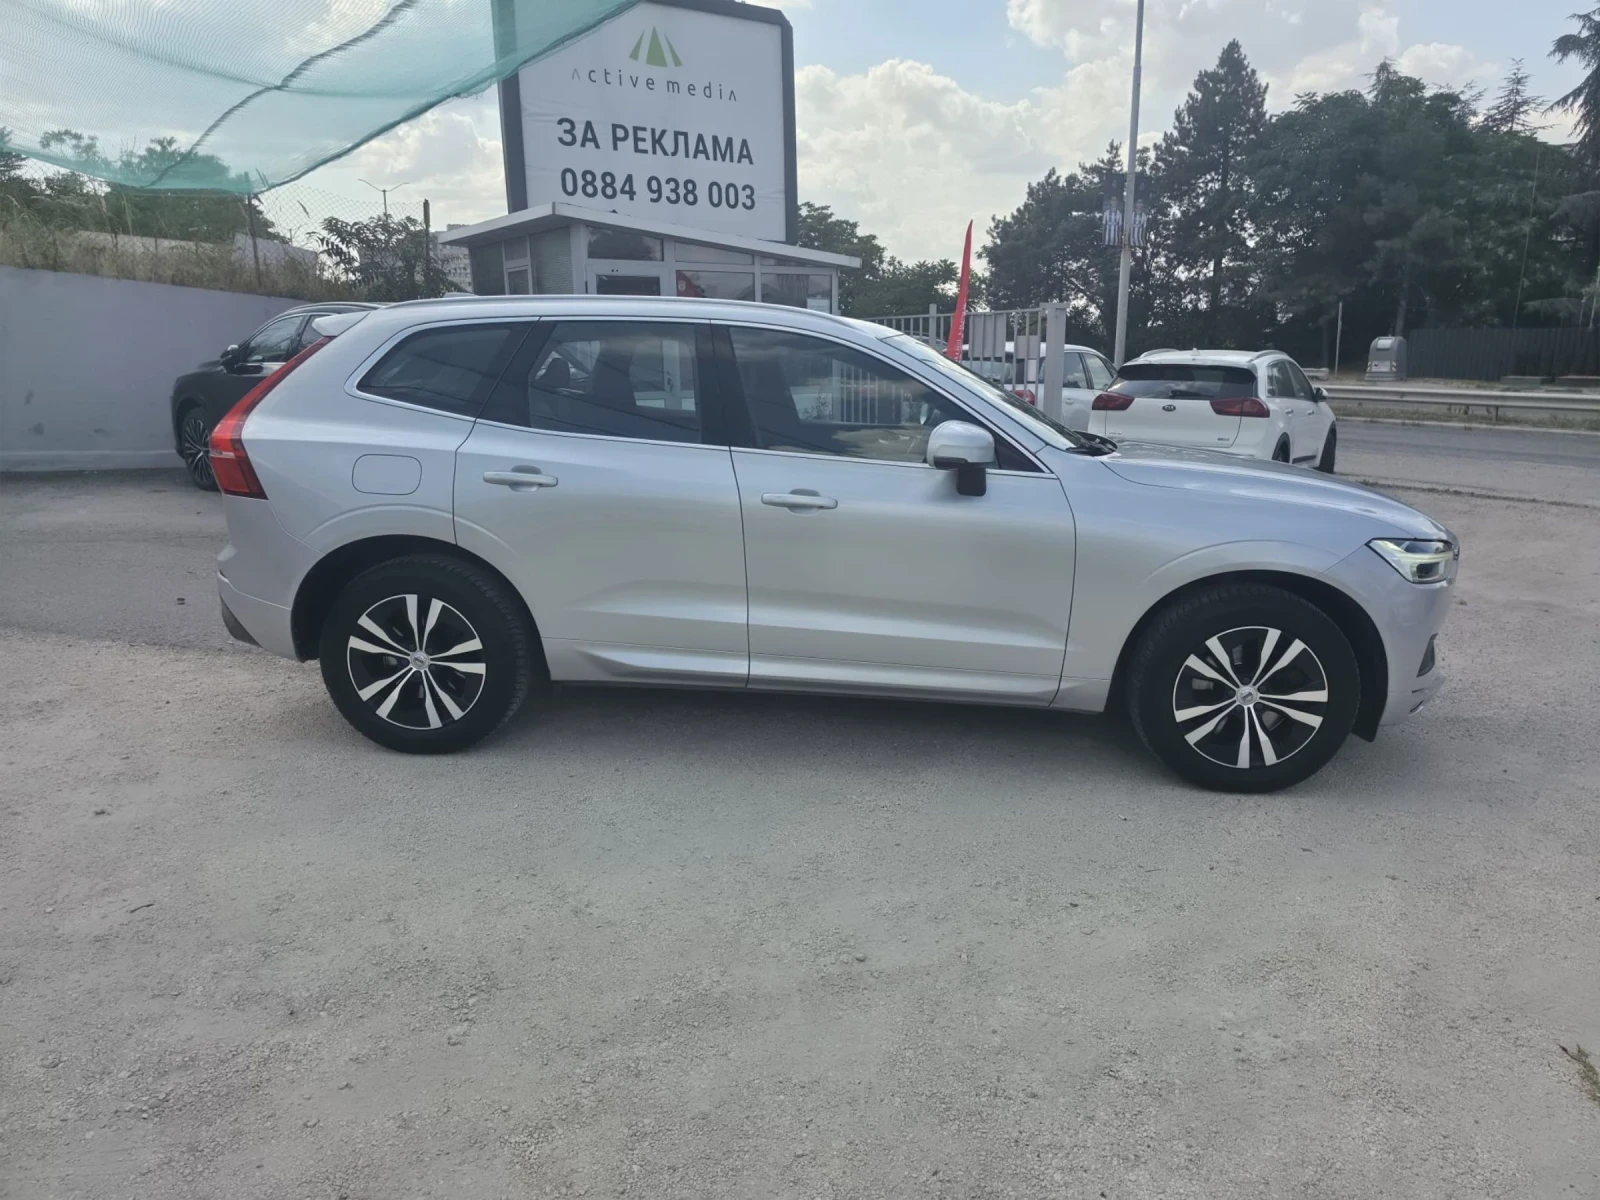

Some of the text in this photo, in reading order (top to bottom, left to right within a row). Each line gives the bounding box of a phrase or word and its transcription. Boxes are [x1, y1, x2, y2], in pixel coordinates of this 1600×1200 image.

[556, 117, 754, 165] ЗА РЕКЛАМА
[560, 167, 756, 211] 0884 938 003
